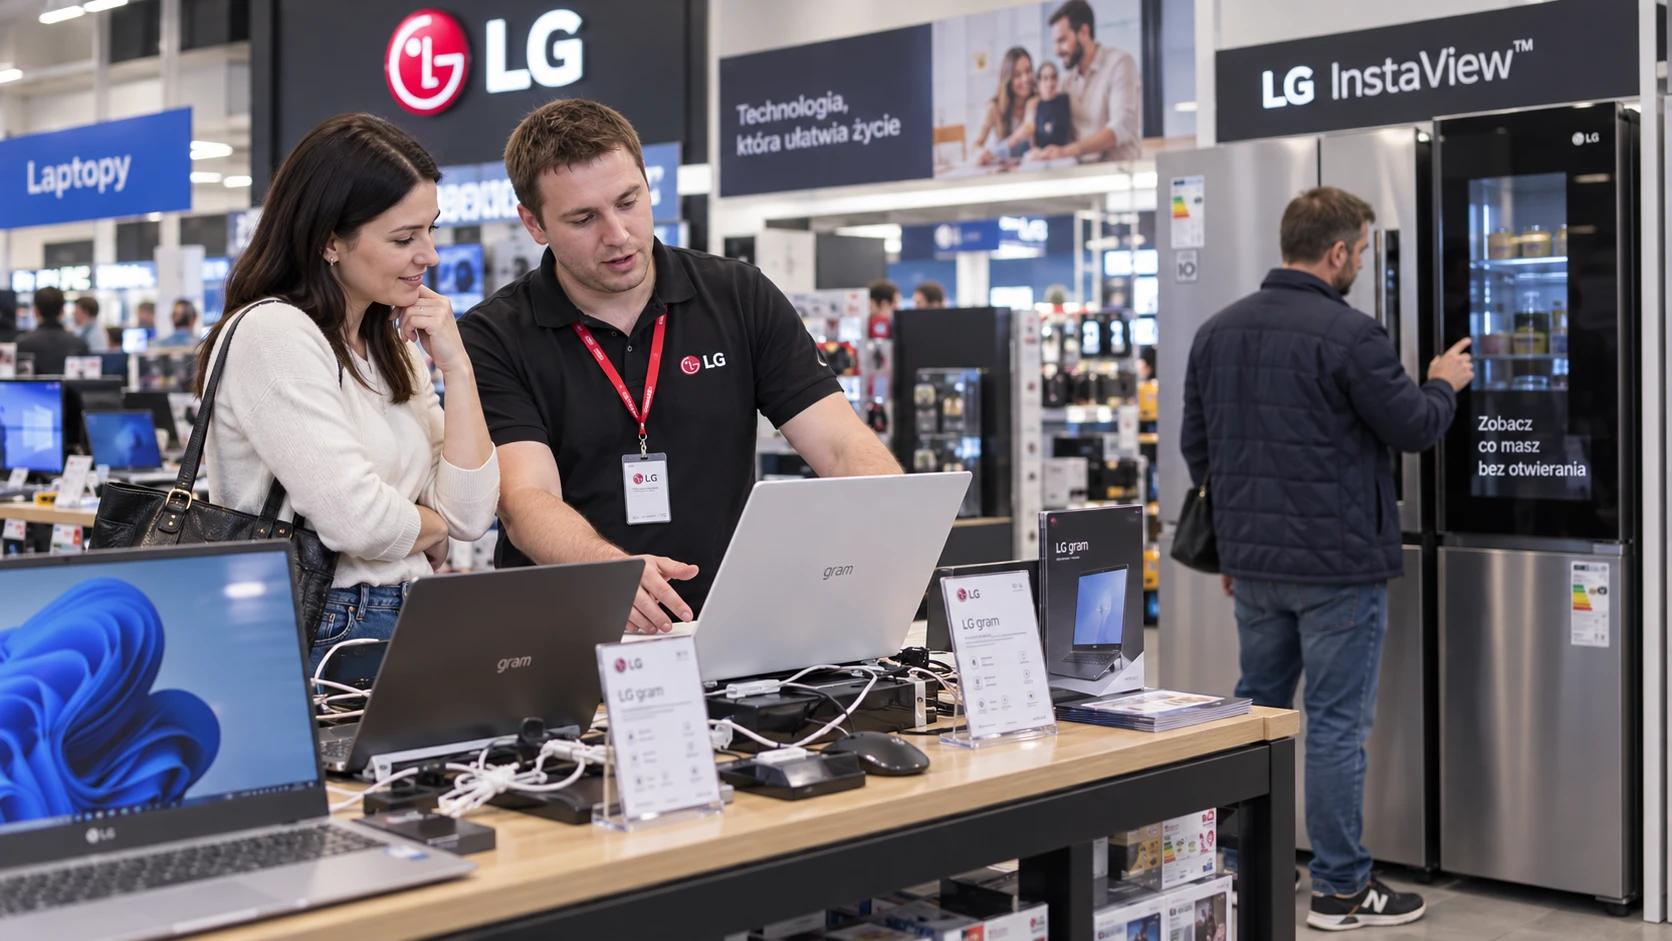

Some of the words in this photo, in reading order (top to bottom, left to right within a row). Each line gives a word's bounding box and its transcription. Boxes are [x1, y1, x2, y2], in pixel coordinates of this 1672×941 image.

[486, 9, 583, 93] LG
[1262, 65, 1315, 109] LG
[736, 90, 849, 126] Technologia,
[736, 131, 781, 156] która
[784, 121, 849, 150] ułatwia
[852, 113, 901, 145] życie
[1585, 131, 1600, 144] LG
[27, 154, 132, 200] Laptopy
[703, 352, 726, 370] LG
[1478, 415, 1534, 432] Zobacz
[1478, 440, 1498, 453] co
[1500, 440, 1541, 454] masz
[1478, 460, 1506, 477] bez
[1508, 460, 1588, 477] otwierania
[644, 473, 658, 483] LG
[1055, 542, 1067, 554] LG
[1068, 540, 1089, 555] gram
[822, 564, 854, 581] gram
[968, 589, 980, 600] LG
[961, 618, 975, 630] LG
[976, 617, 1000, 632] gram
[497, 655, 532, 674] gram
[628, 657, 643, 671] LG
[618, 688, 634, 703] LG
[636, 685, 664, 703] gram
